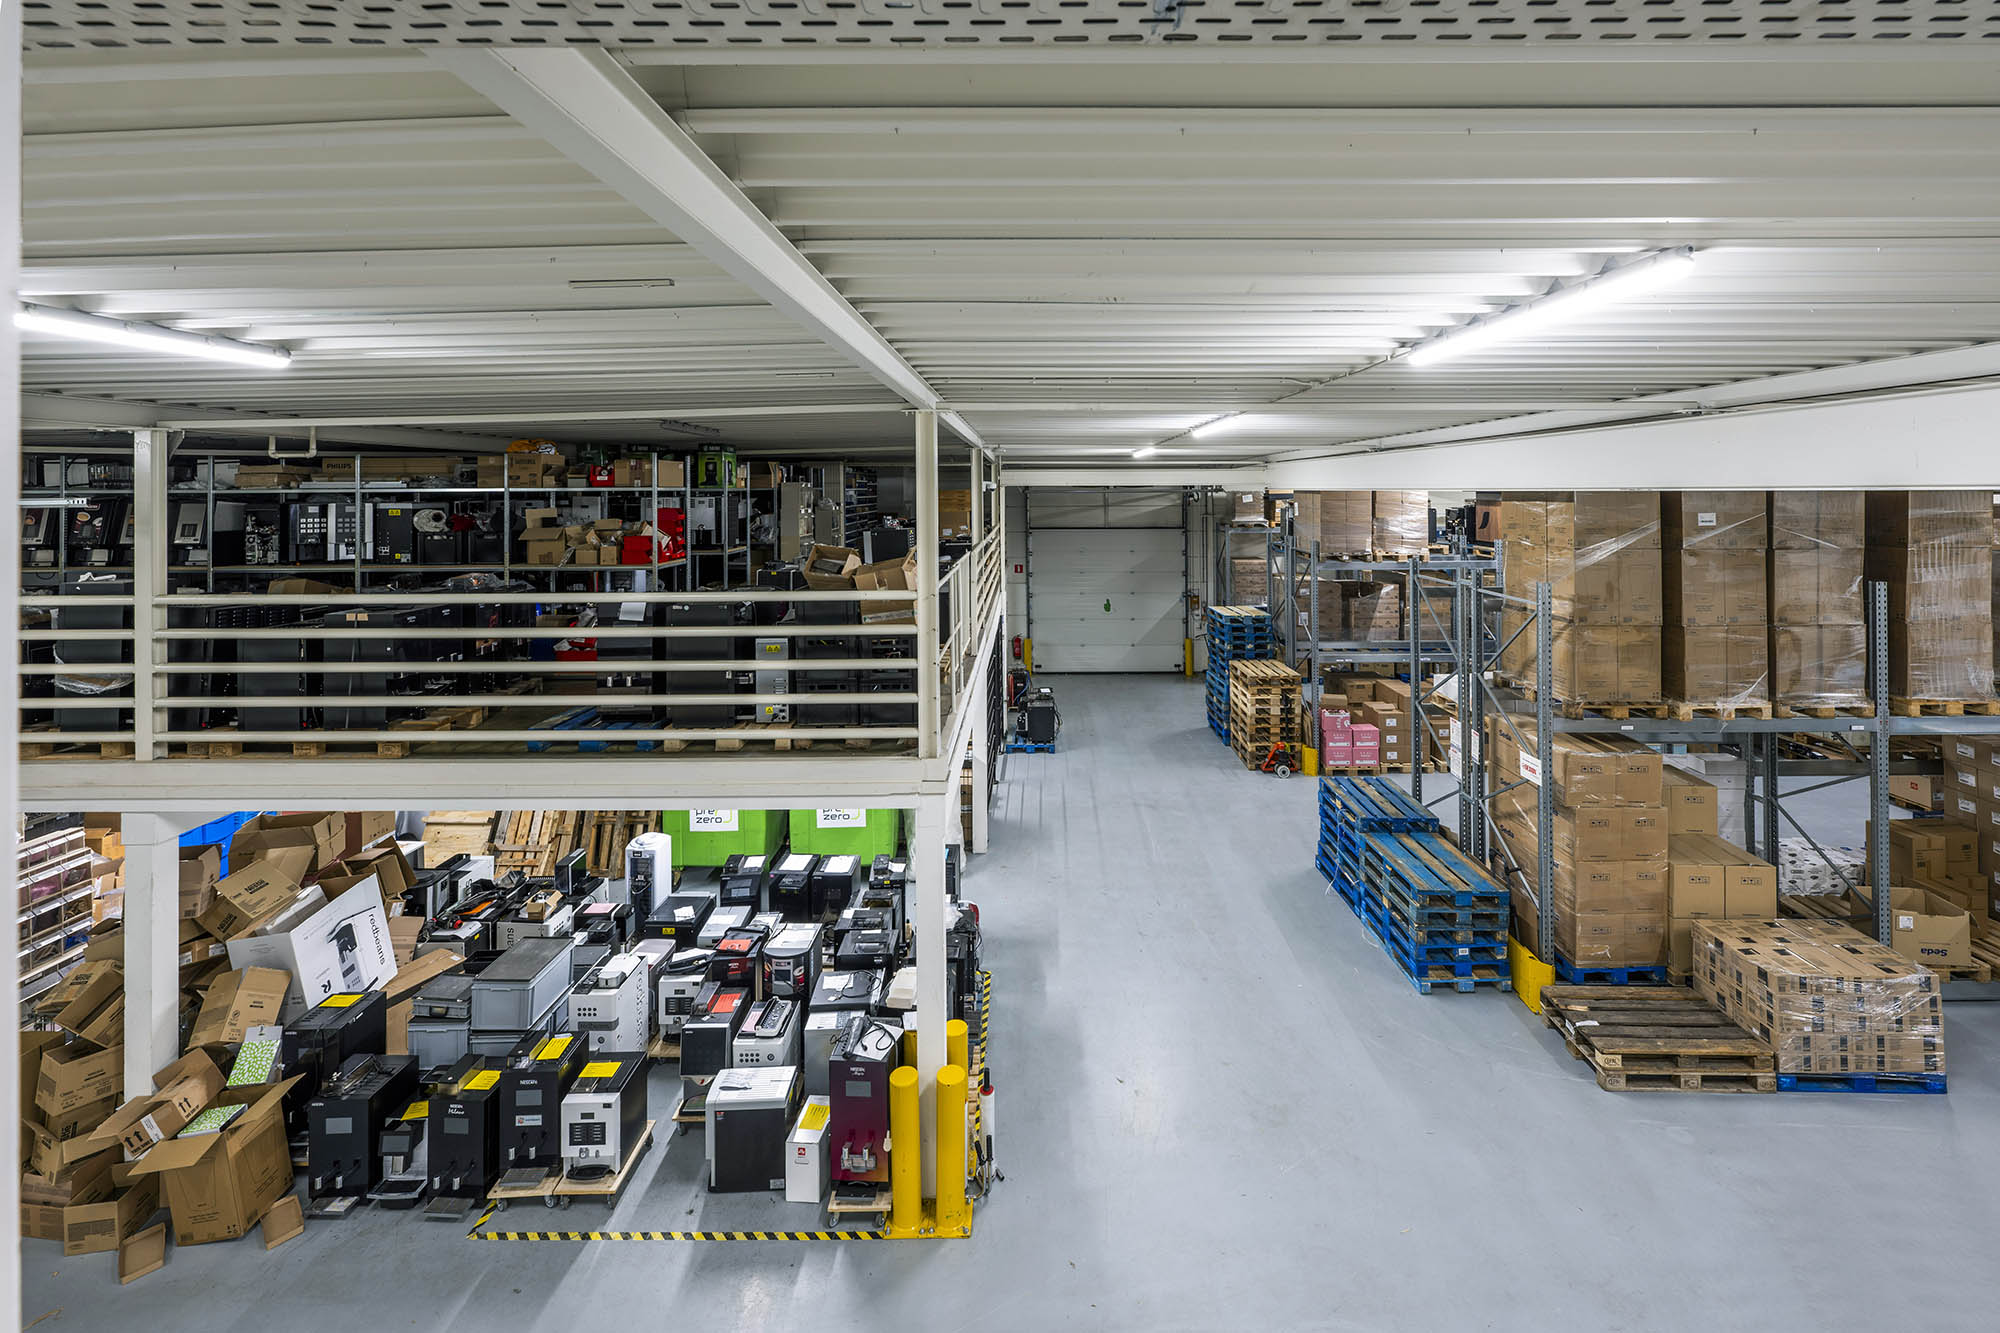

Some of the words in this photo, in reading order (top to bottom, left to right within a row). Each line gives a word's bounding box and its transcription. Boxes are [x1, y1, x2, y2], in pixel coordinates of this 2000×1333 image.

[695, 815, 723, 824] zero
[823, 813, 850, 821] zero
[368, 913, 386, 966] redbeans
[1920, 947, 1949, 957] Seda
